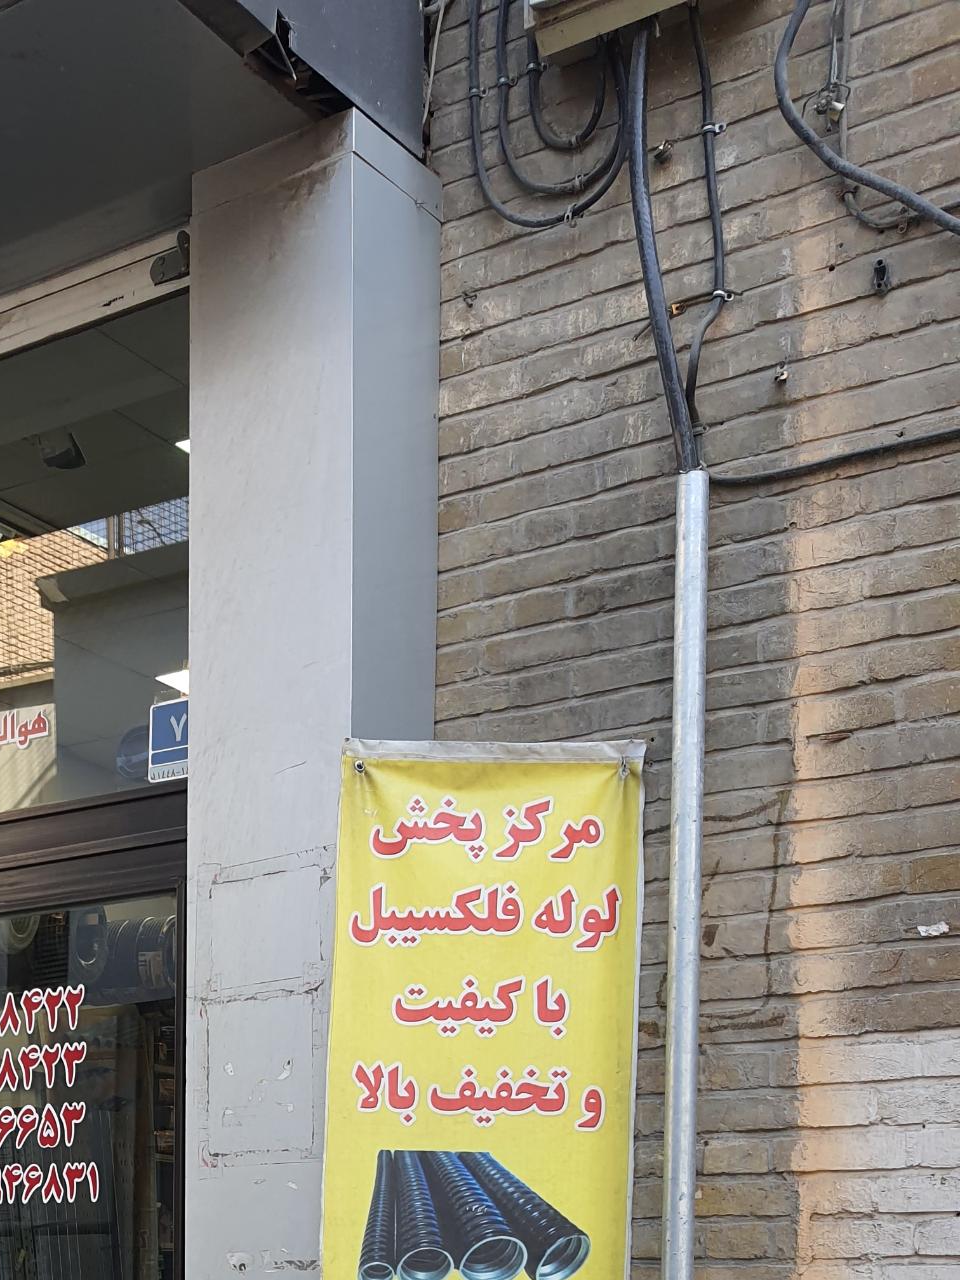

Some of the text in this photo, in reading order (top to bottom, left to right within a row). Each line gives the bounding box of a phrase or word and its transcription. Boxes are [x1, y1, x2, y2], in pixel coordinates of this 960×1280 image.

[370, 796, 604, 862] مرکز پخش
[349, 883, 622, 952] لوله فلکسیبل
[392, 975, 569, 1038] با کیفیت
[352, 1060, 604, 1130] و تخفیف بالا
